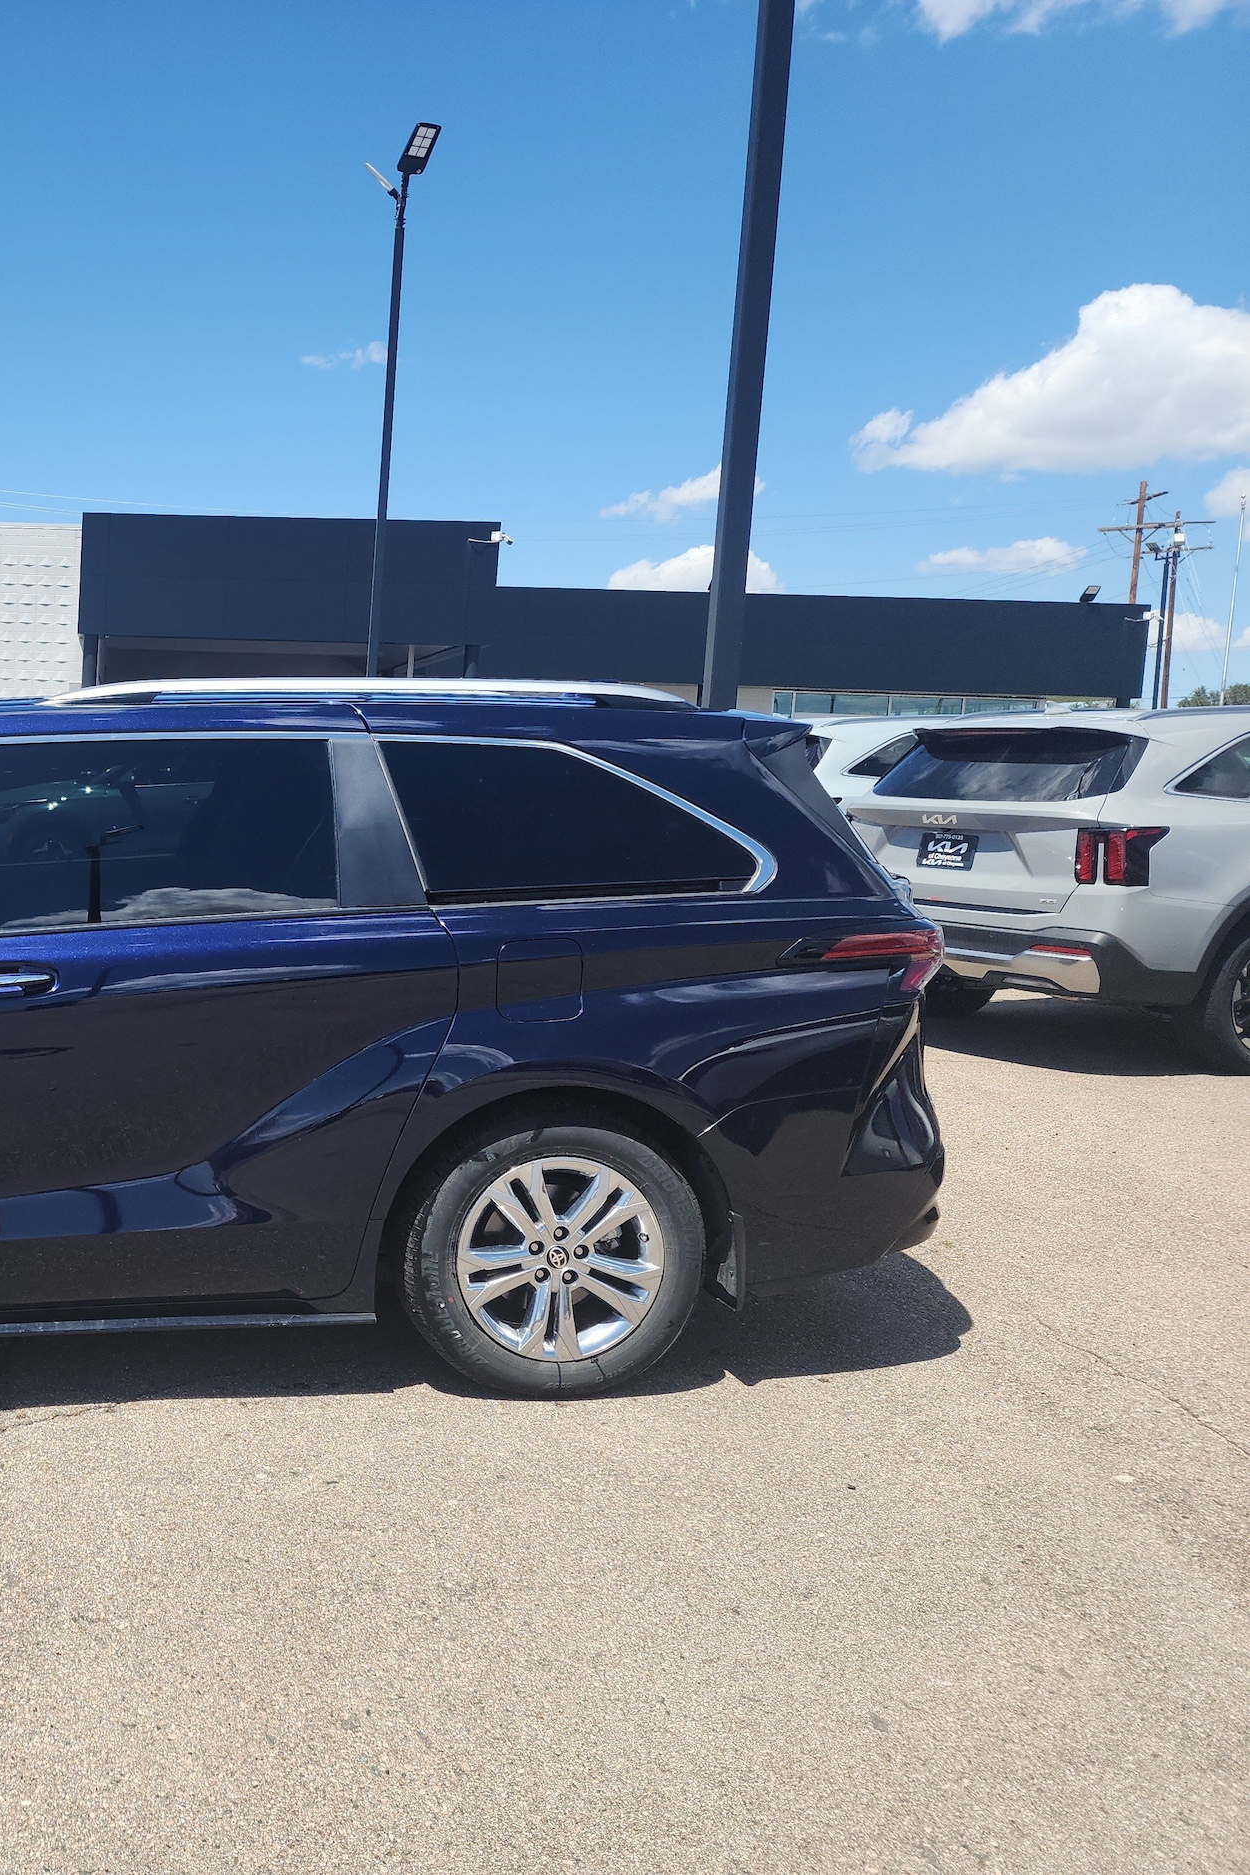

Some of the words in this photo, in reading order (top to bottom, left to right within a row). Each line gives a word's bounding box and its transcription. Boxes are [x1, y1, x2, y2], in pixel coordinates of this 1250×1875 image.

[921, 814, 958, 825] KIA
[927, 840, 968, 854] KIA
[922, 858, 942, 866] KIA
